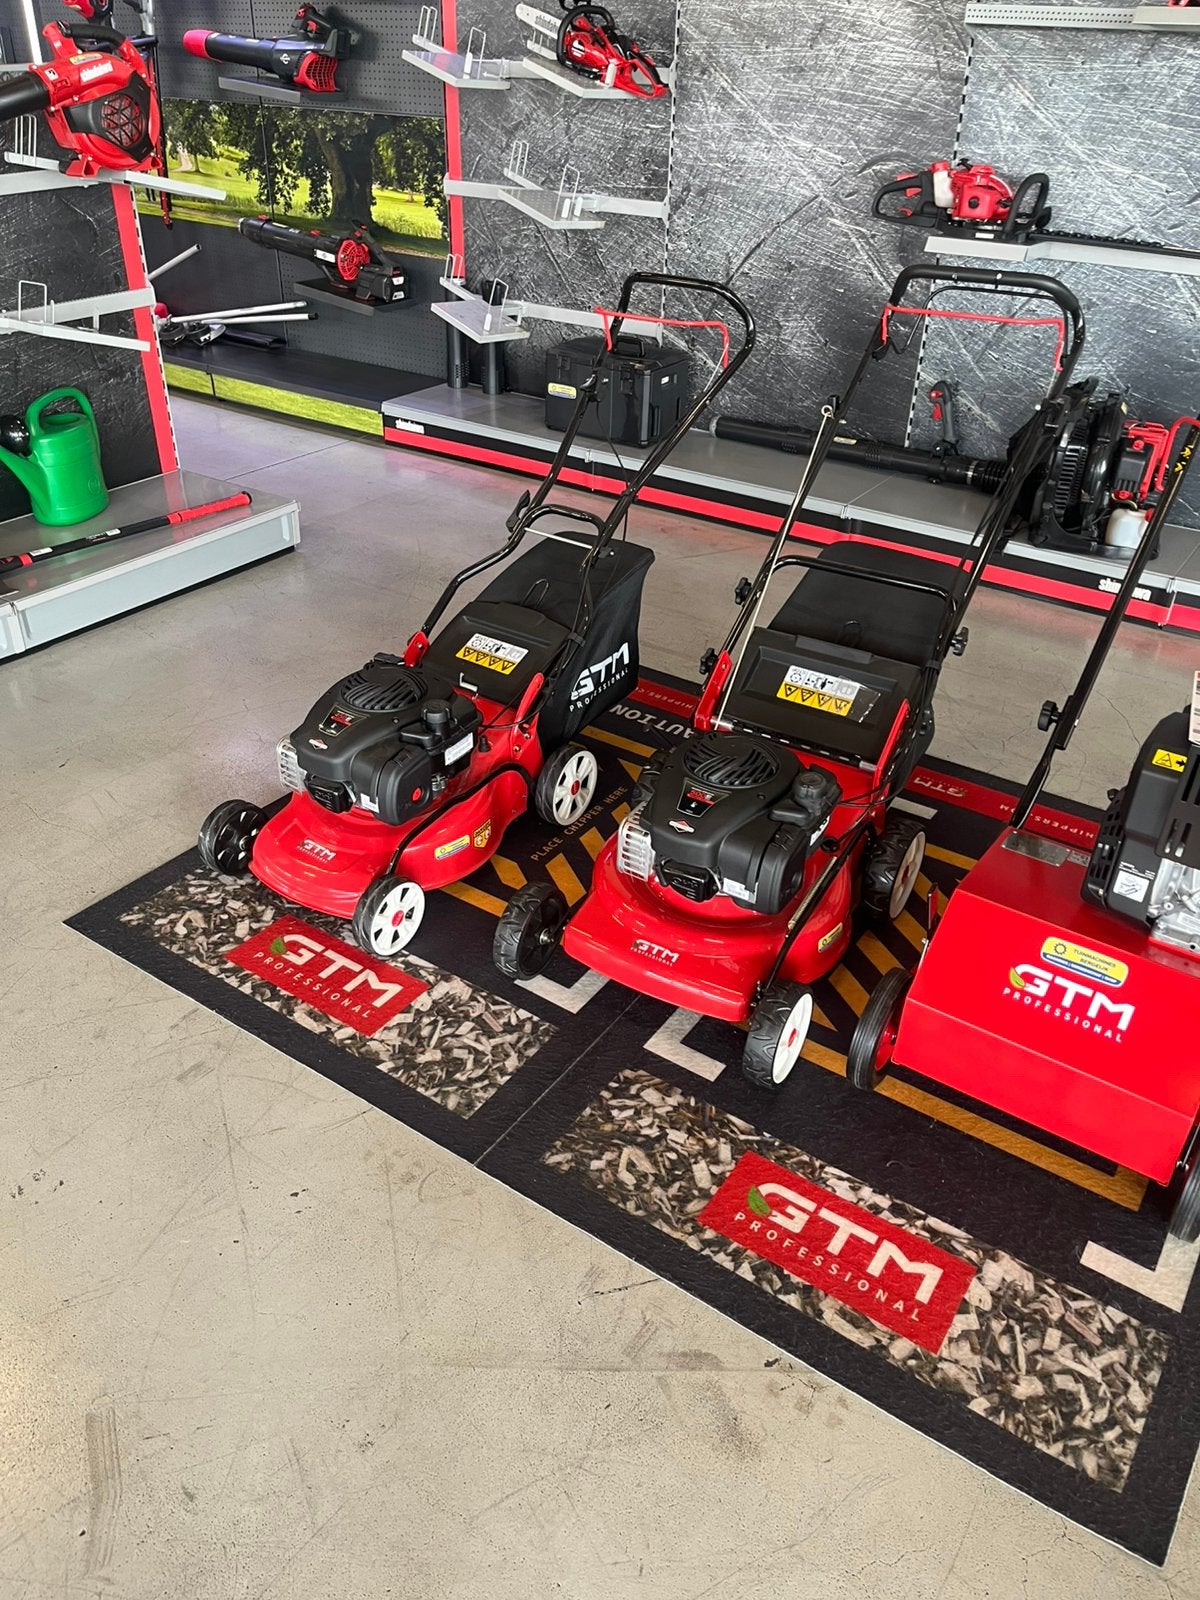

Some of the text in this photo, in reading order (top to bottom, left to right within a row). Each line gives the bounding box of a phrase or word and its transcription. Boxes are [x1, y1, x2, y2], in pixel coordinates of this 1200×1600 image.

[1098, 577, 1152, 601] shinwa
[570, 642, 630, 701] GTM
[609, 704, 696, 739] AUTION
[913, 776, 966, 798] GTM
[301, 838, 337, 861] GTM
[530, 785, 629, 861] PLACE CHIPPER HERE
[270, 933, 404, 1009] GTM
[633, 939, 680, 964] GTM
[253, 950, 374, 1019] PROFESSIONAL
[1009, 963, 1136, 1031] GTM
[1002, 986, 1123, 1043] PROFESSIONAL
[734, 1211, 920, 1321] PROFESSIONAL
[748, 1182, 944, 1305] GTM
